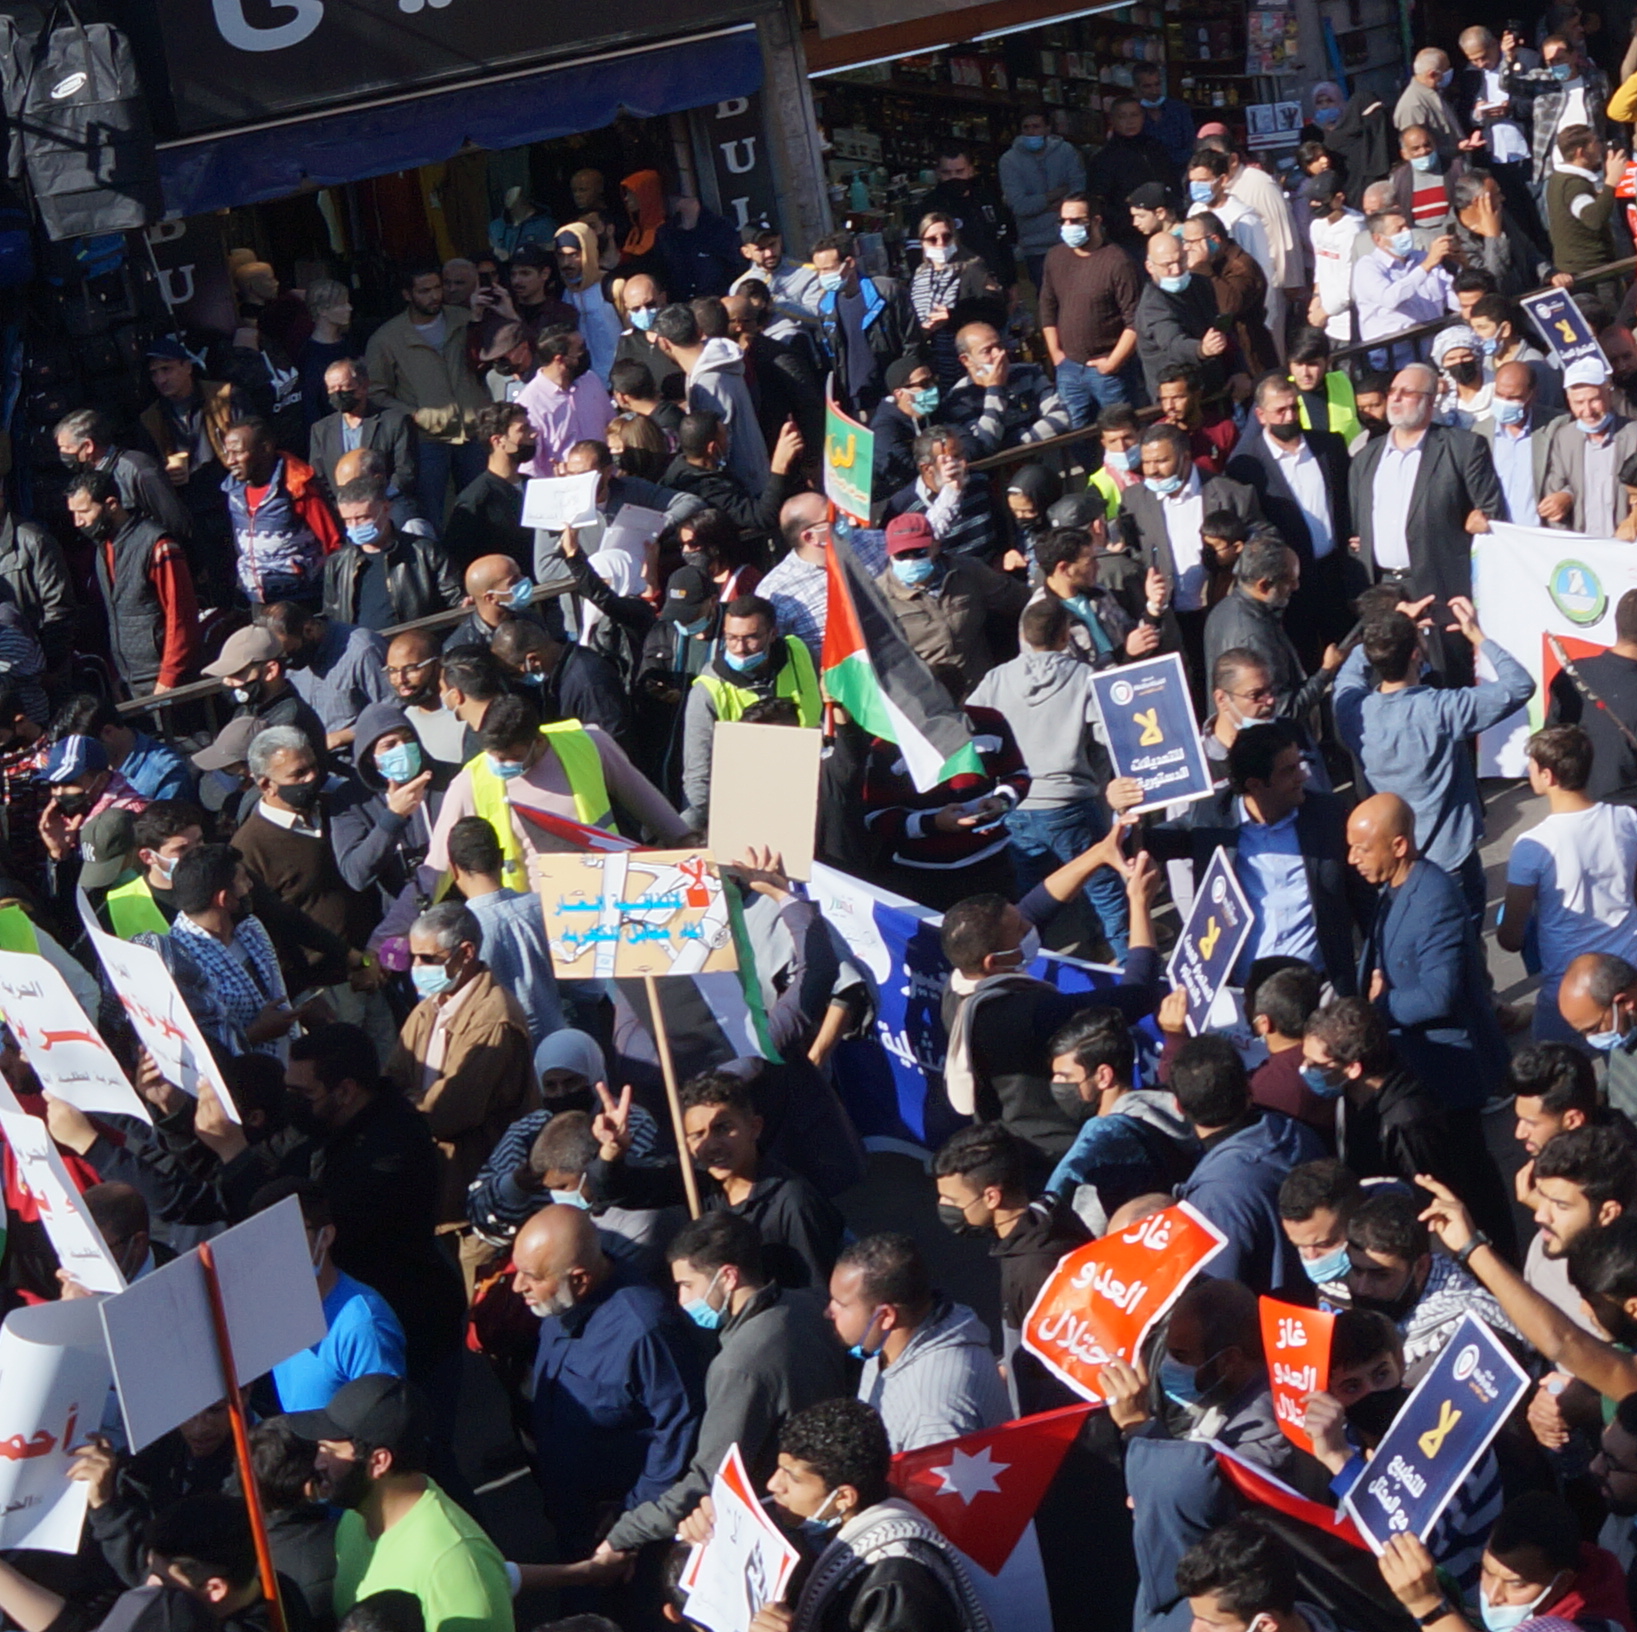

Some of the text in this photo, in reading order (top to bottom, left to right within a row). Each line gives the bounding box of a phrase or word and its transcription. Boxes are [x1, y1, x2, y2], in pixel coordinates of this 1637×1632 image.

[1554, 319, 1578, 344] لا
[1132, 707, 1164, 747] لا
[1129, 748, 1186, 773] للتعديلات
[626, 921, 671, 945] مقابل
[1122, 1214, 1173, 1250] غاز
[1071, 1261, 1149, 1315] العدو
[1276, 1317, 1308, 1349] غاز
[1273, 1362, 1317, 1393] العدو
[1417, 1399, 1462, 1460] لا
[1386, 1454, 1427, 1499] للتطبيع
[1367, 1473, 1410, 1532] مع المحتل
